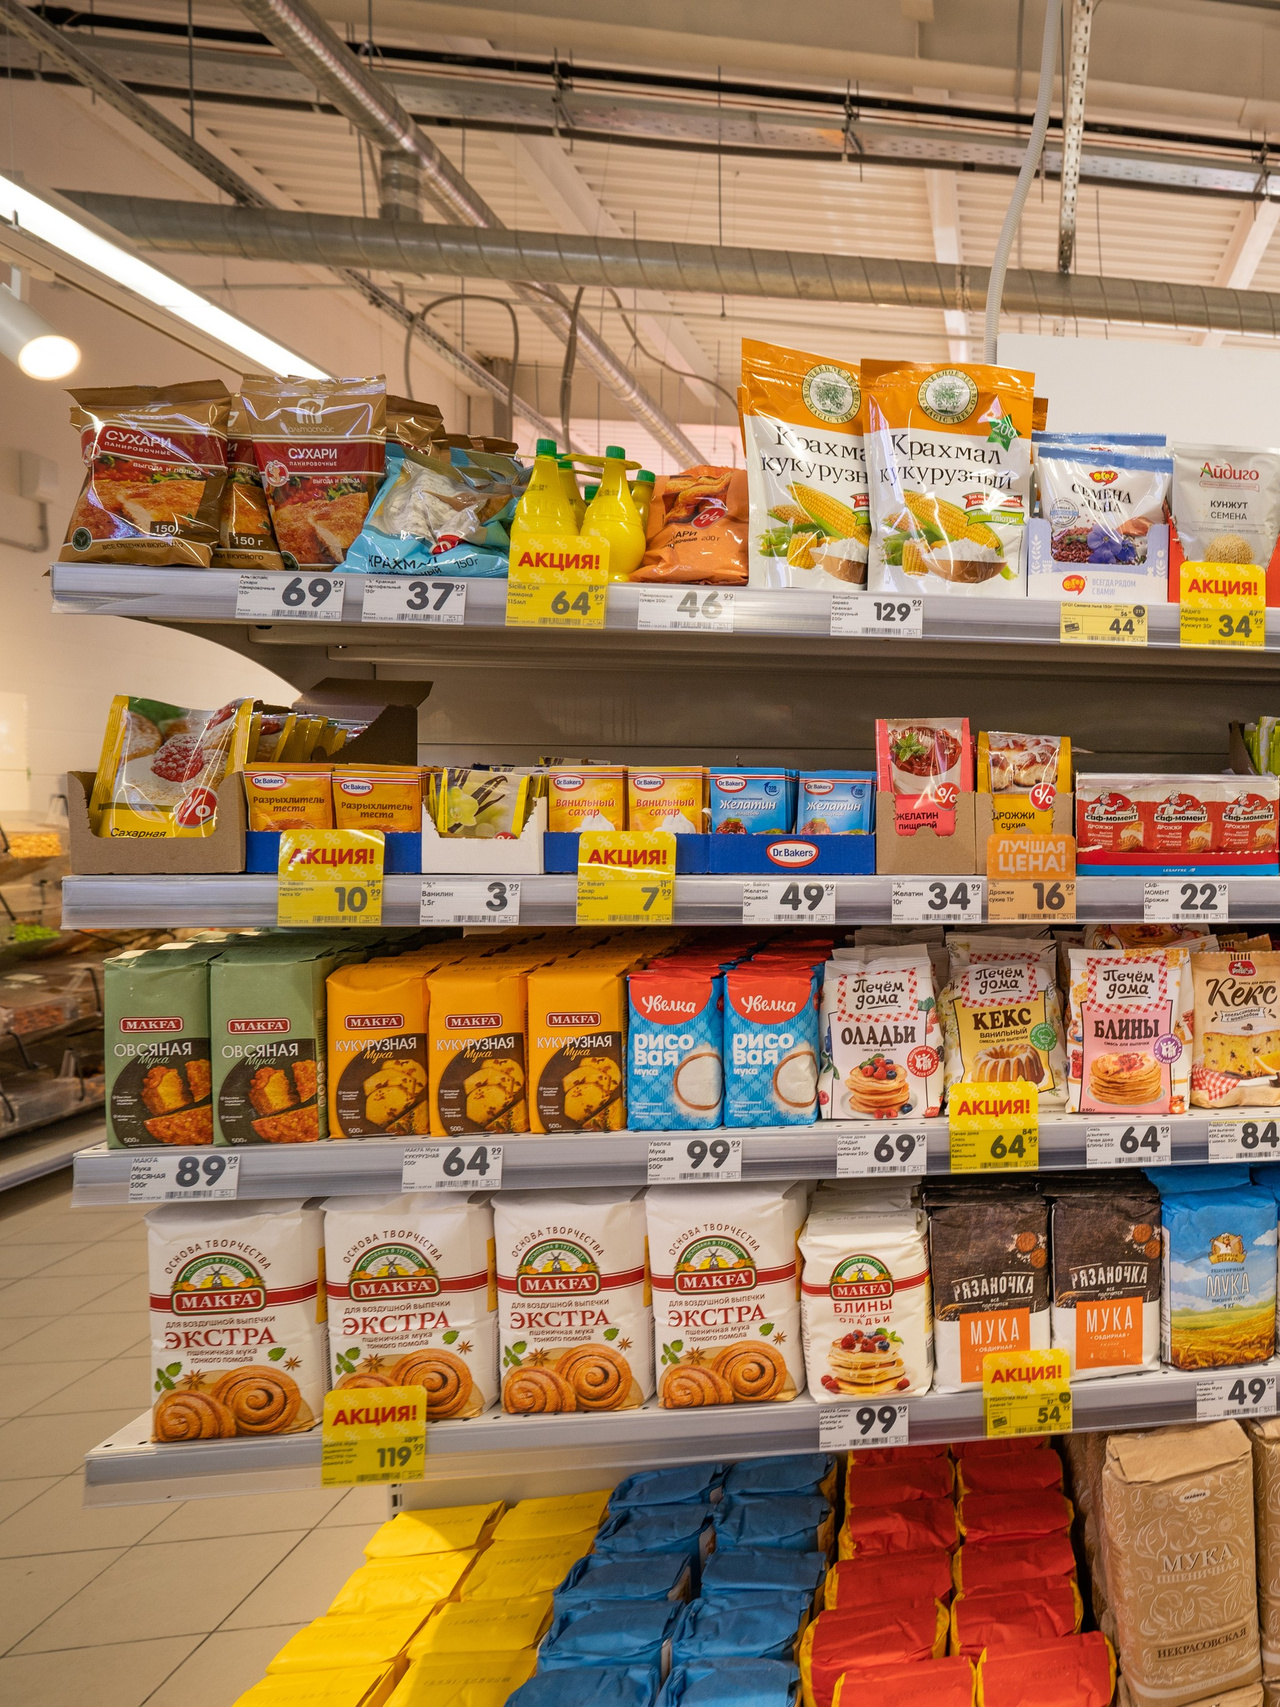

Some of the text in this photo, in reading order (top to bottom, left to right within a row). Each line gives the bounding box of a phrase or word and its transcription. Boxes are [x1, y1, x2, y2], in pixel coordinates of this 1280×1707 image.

[104, 441, 171, 456] ПАНИРОВОЧНЫЕ
[106, 430, 171, 448] СУХАРИ
[889, 433, 1001, 465] Крахмал
[880, 464, 1013, 490] кукурузный
[1200, 462, 1259, 481] Айдиго
[1071, 483, 1132, 504] СЕМЕНА
[1210, 500, 1248, 509] КУНЖУТ
[1211, 512, 1247, 520] СЕМЕНА
[518, 552, 600, 570] АКЦИЯ!
[281, 578, 332, 607] 69
[1092, 579, 1113, 587] ВСЕГДА
[1188, 580, 1258, 596] АКЦИЯ!
[406, 582, 454, 611] 37
[550, 591, 591, 615] 64
[677, 590, 723, 619] 46
[873, 602, 911, 622] 129
[1109, 619, 1135, 634] 44
[1218, 615, 1252, 638] 34
[253, 796, 324, 805] Разрыхлитель
[273, 804, 306, 812] теста
[556, 799, 615, 807] Ванильный
[719, 799, 777, 810] Желатин
[568, 808, 600, 818] сахар
[896, 812, 939, 822] ЖЕЛАТИН
[992, 811, 1035, 821] ДРОЖЖИ
[288, 848, 374, 866] АКЦИЯ!
[998, 841, 1065, 854] ЛУЧШАЯ
[588, 850, 667, 867] АКЦИЯ!
[1000, 855, 1066, 874] ЦЕНА!
[334, 887, 367, 912] 10
[486, 882, 507, 911] 3
[641, 887, 659, 911] 7
[780, 882, 824, 910] 49
[928, 882, 970, 910] 34
[1033, 882, 1065, 910] 16
[1180, 884, 1218, 910] 22
[1103, 969, 1155, 983] Печём
[853, 979, 905, 994] Печём
[1106, 983, 1149, 999] дома
[1206, 978, 1278, 1007] Кекс
[642, 995, 696, 1014] Увелка
[855, 993, 898, 1009] дома
[126, 1020, 176, 1029] MAKFA
[451, 1017, 496, 1026] MAKFA
[973, 1008, 1032, 1030] КЕКС
[841, 1026, 916, 1047] ОЛАДЬИ
[980, 1027, 1027, 1038] ВАНИЛЬНЫЙ
[1094, 1019, 1159, 1040] БЛИНЫ
[114, 1042, 192, 1057] ОВСЯНАЯ
[437, 1036, 514, 1051] КУКУРУЗНАЯ
[634, 1034, 694, 1050] рисо
[138, 1054, 169, 1069] Мука
[464, 1050, 492, 1063] Мука
[634, 1050, 678, 1065] вая
[634, 1068, 658, 1076] мука
[957, 1099, 1030, 1118] АКЦИЯ!
[1120, 1126, 1160, 1153] 64
[1241, 1122, 1280, 1149] 84
[686, 1140, 730, 1169] 99
[874, 1134, 915, 1163] 69
[990, 1135, 1026, 1158] 64
[443, 1147, 490, 1176] 64
[176, 1156, 238, 1187] 89 99
[165, 1239, 271, 1274] ОСНОВА ТВОРЧЕСТВА
[836, 1285, 887, 1296] MAKFA
[954, 1276, 1034, 1301] РЯЗАНОЧКА
[1206, 1272, 1250, 1297] МУКА
[181, 1293, 253, 1309] MAKFA
[834, 1300, 892, 1313] БЛИНЫ
[182, 1318, 234, 1328] ВОЗДУШНОЙ
[236, 1316, 275, 1325] ВЫПЕЧКИ
[970, 1317, 1020, 1345] МУКА
[164, 1327, 277, 1349] ЭКСТРА
[991, 1365, 1062, 1384] АКЦИЯ!
[1228, 1378, 1266, 1405] 49
[332, 1406, 418, 1426] АКЦИЯ!
[855, 1406, 897, 1435] 99
[1037, 1406, 1061, 1424] 54
[377, 1446, 412, 1468] 119
